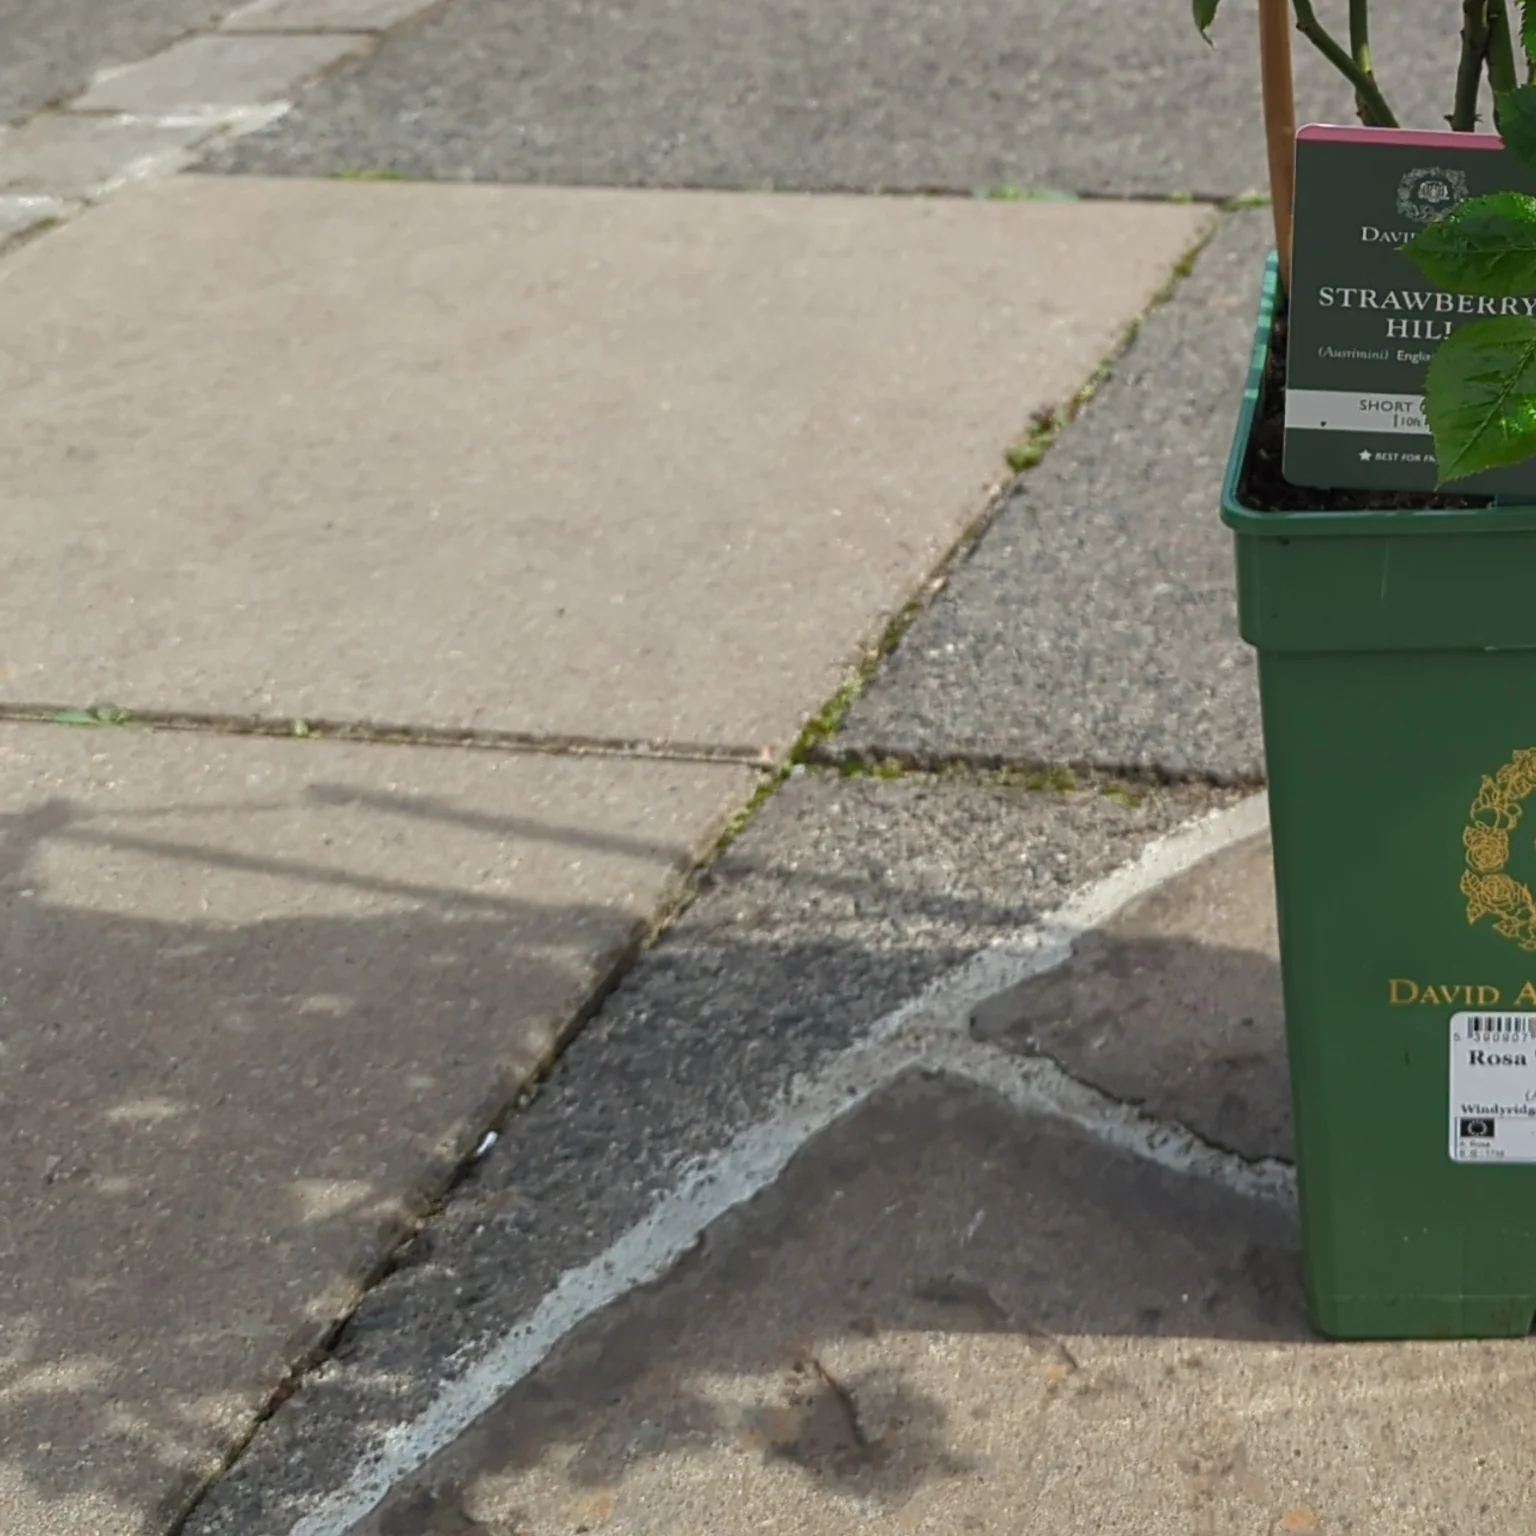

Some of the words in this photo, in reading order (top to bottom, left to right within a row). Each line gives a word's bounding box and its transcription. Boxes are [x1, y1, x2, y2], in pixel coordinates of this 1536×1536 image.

[1359, 399, 1414, 414] SHORT
[1374, 452, 1399, 462] BEST
[1400, 453, 1422, 463] FOR
[1388, 978, 1500, 1005] DAVID
[1468, 1049, 1527, 1066] Rosa
